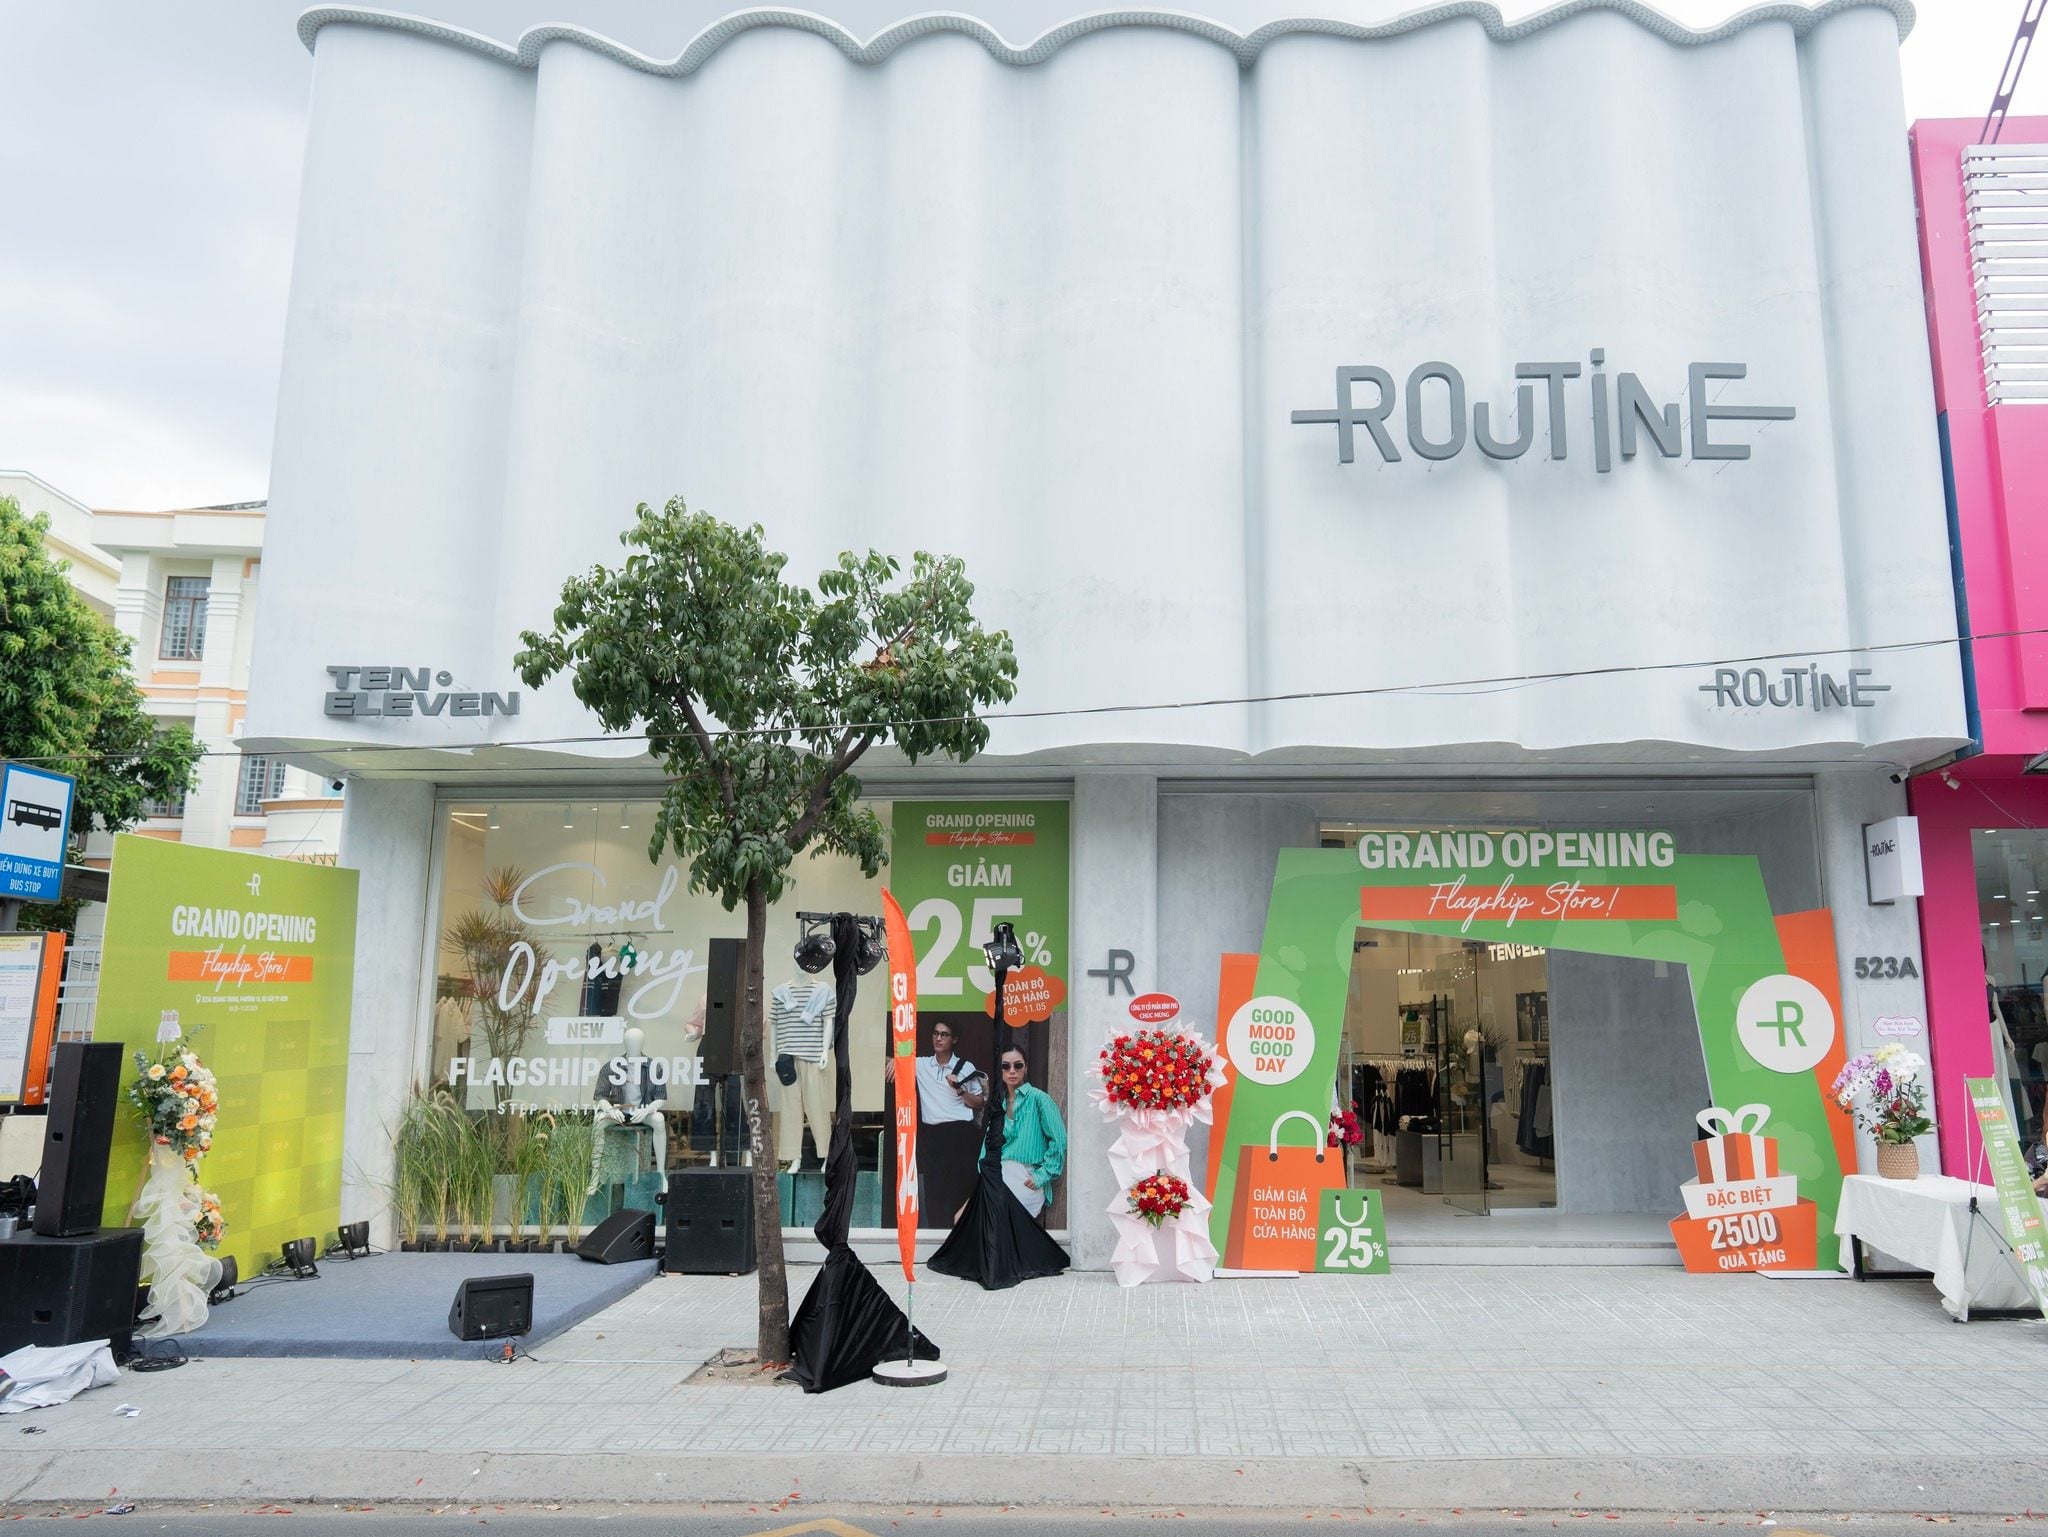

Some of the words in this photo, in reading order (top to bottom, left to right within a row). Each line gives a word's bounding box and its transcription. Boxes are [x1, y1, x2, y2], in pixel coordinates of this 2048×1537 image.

[1290, 347, 1797, 473] ROUTINE
[326, 665, 430, 691] TEN
[1698, 662, 1892, 712] ROUTINE
[323, 691, 521, 717] ELEVEN
[925, 814, 974, 828] GRAND
[975, 813, 1036, 828] OPENING
[948, 828, 986, 850] Flagship
[1358, 832, 1495, 870] GRAND
[1501, 831, 1675, 869] OPENING
[33, 865, 42, 877] XE
[947, 857, 1012, 887] GIẢM
[10, 878, 24, 891] BUS
[24, 880, 42, 893] STOP
[512, 862, 679, 930] Grand
[1428, 873, 1534, 933] Flagship
[171, 905, 241, 939] GRAND
[242, 911, 316, 944] OPENING
[200, 943, 252, 992] Flagship
[1854, 956, 1920, 980] 523A
[498, 940, 709, 1020] Opening
[1003, 980, 1029, 993] TOÀN
[1031, 976, 1045, 990] BỘ
[1022, 990, 1051, 1003] HÀNG
[1007, 1007, 1018, 1016] 09
[1024, 1002, 1047, 1014] 11.05
[1139, 1011, 1153, 1019] CHÚC
[1252, 1008, 1295, 1025] GOOD
[567, 1022, 604, 1039] NEW
[1249, 1024, 1296, 1041] MOOD
[1250, 1040, 1293, 1057] GOOD
[448, 1056, 602, 1087] FLAGSHIP
[608, 1056, 710, 1087] STORE
[1255, 1057, 1286, 1073] DAY
[497, 1103, 538, 1116] STEP
[1253, 1186, 1285, 1202] GIẢM
[1287, 1188, 1308, 1203] GIÁ
[1706, 1189, 1737, 1208] ĐẶC
[1740, 1186, 1772, 1206] BIỆT
[1253, 1205, 1286, 1221] TOÀN
[1289, 1206, 1306, 1223] BỘ
[1253, 1222, 1278, 1239] CỬA
[1281, 1224, 1316, 1240] HÀNG
[1707, 1211, 1778, 1250] 2500
[1718, 1251, 1748, 1270] QUÀ
[1749, 1248, 1786, 1267] TẶNG
